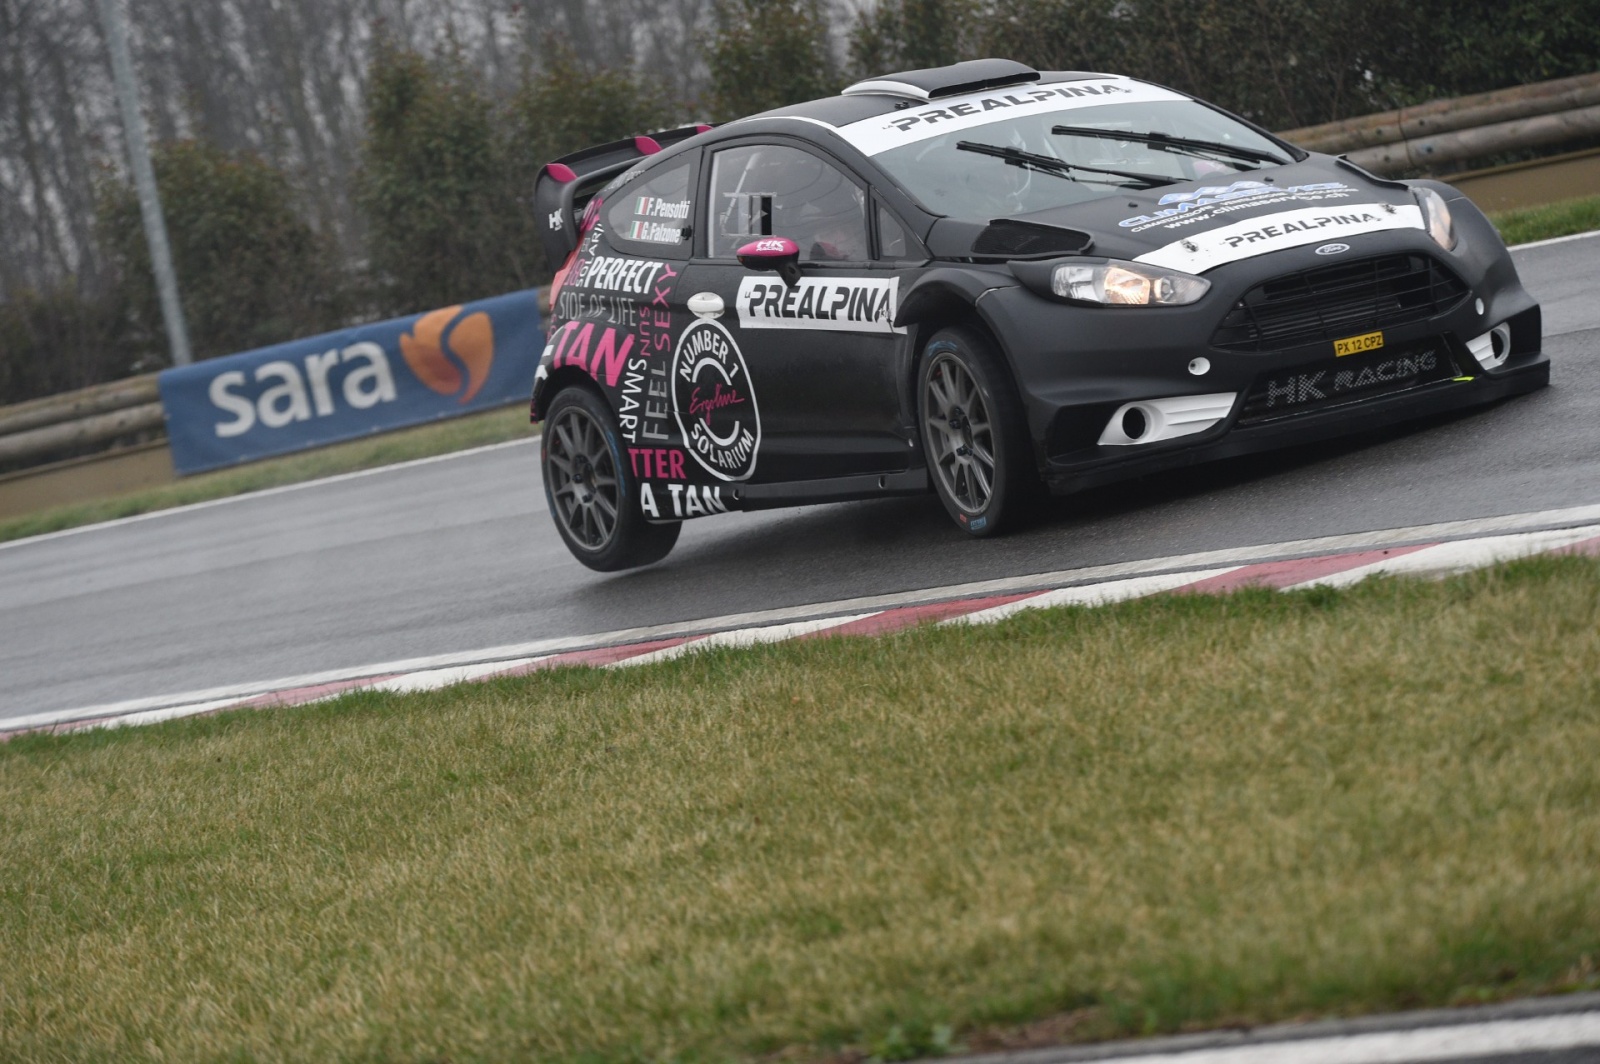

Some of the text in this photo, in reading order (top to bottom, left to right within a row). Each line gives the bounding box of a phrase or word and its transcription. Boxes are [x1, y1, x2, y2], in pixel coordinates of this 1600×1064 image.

[891, 84, 1121, 132] PREALPINA
[647, 200, 690, 219] F.Pensotti
[641, 224, 681, 243] G.Falzone
[756, 240, 786, 249] HK
[1225, 213, 1377, 248] PREALPINA
[584, 256, 664, 294] PERFECT
[559, 291, 636, 326] SIDE OF LIFE
[749, 284, 890, 323] PREALPINA
[553, 320, 635, 387] TAN
[642, 263, 678, 440] FEEL SEXY
[679, 330, 728, 382] NUMBER
[1337, 343, 1350, 354] PX
[1352, 341, 1362, 351] 12
[209, 341, 397, 437] sara
[1267, 350, 1437, 408] HK RACING
[619, 358, 647, 443] SMART
[691, 423, 754, 469] SOLARIUM
[640, 482, 729, 517] A TAN
